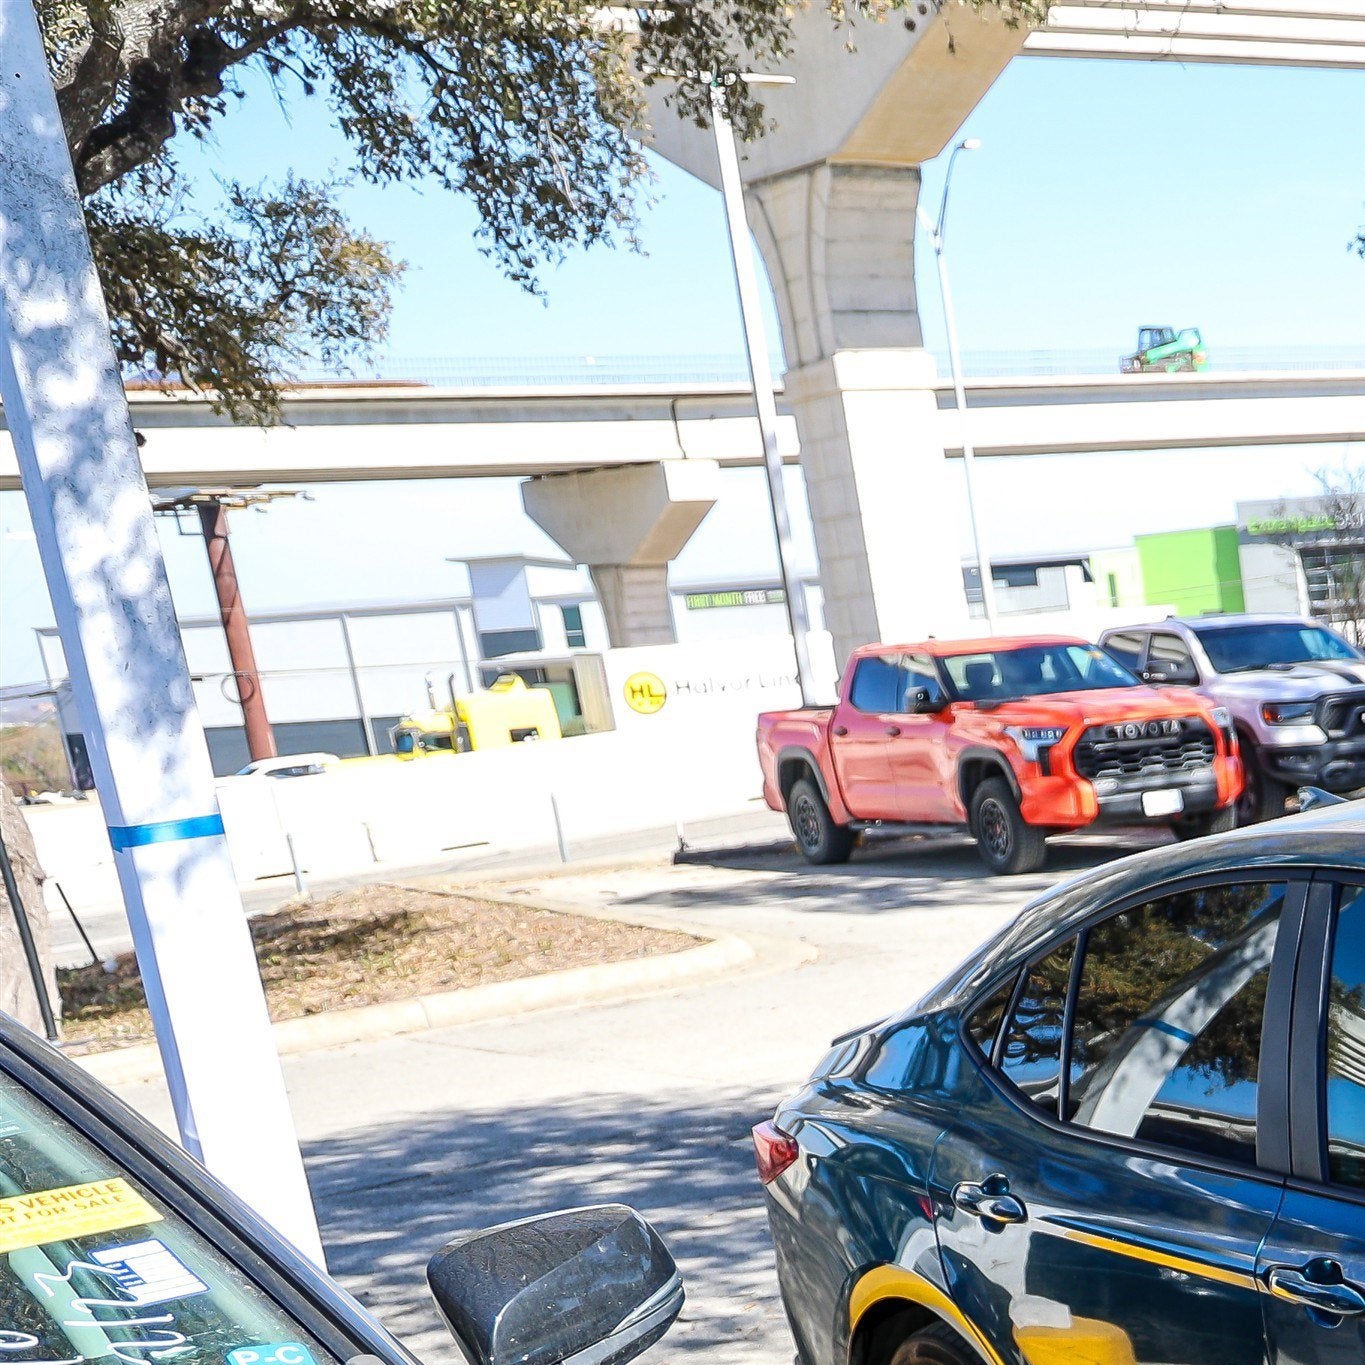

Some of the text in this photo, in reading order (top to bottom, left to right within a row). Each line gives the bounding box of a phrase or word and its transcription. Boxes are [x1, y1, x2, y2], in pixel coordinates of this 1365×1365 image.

[629, 683, 668, 699] HL
[1114, 720, 1182, 739] TOYOTA
[18, 1182, 124, 1209] VEHICLE
[24, 1206, 67, 1220] FOR
[74, 1195, 125, 1210] SALE
